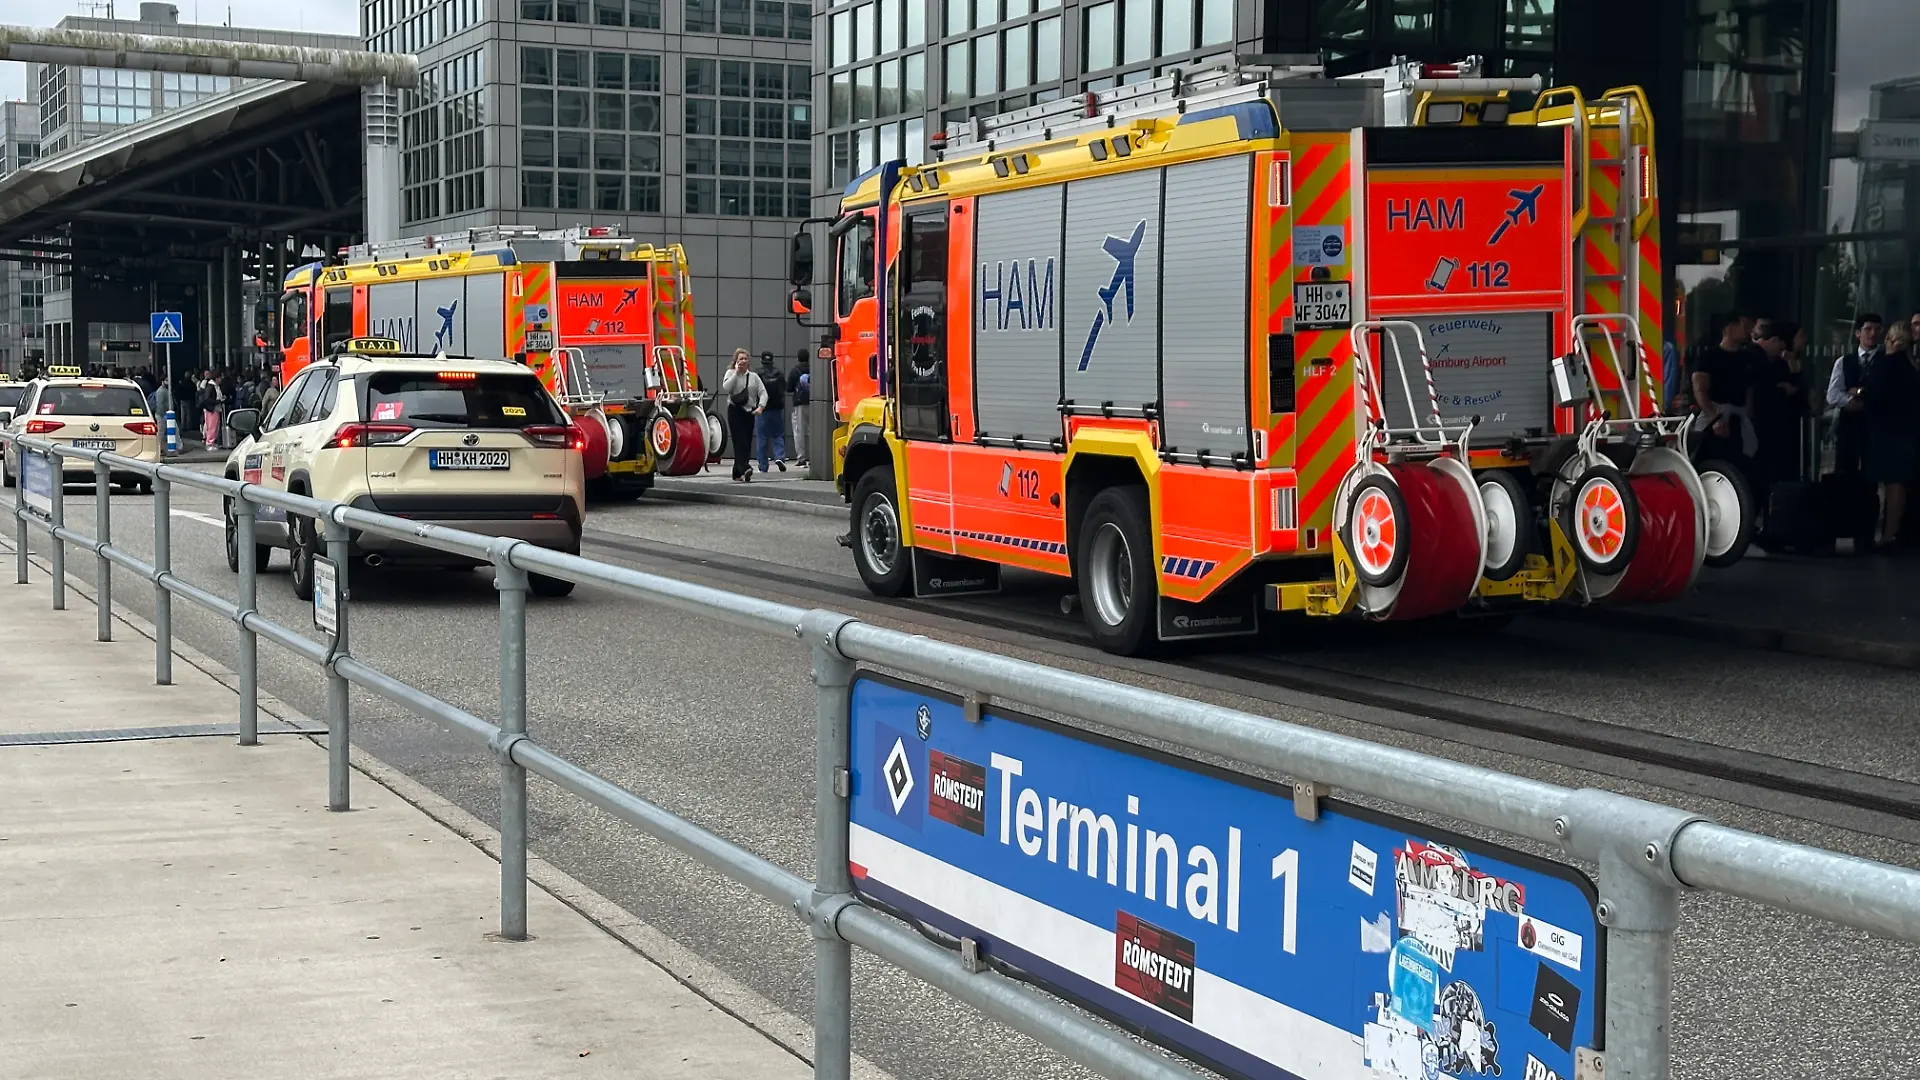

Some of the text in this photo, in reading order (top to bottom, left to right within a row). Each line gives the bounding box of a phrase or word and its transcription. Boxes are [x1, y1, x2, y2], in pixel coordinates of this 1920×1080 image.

[1388, 197, 1464, 231] HAM
[1466, 260, 1510, 288] 112
[567, 293, 604, 307] HAM
[982, 256, 1055, 332] HAM
[1305, 287, 1323, 303] HH
[1314, 304, 1347, 321] 3047
[604, 321, 625, 333] 112
[1428, 319, 1503, 337] Feuerwehr
[359, 340, 391, 350] TAXI
[1472, 355, 1508, 367] Airport
[1303, 365, 1338, 377] HLF 2
[1452, 396, 1461, 406] &
[1464, 390, 1502, 406] Rescue
[1494, 412, 1507, 422] AT
[438, 451, 508, 466] HH KH 2029
[1017, 468, 1040, 500] 112
[933, 770, 984, 812] RÖMSTEDT
[990, 751, 1299, 955] Terminal 1
[1550, 932, 1565, 947] GIG
[1122, 936, 1192, 993] RÖMSTEDT
